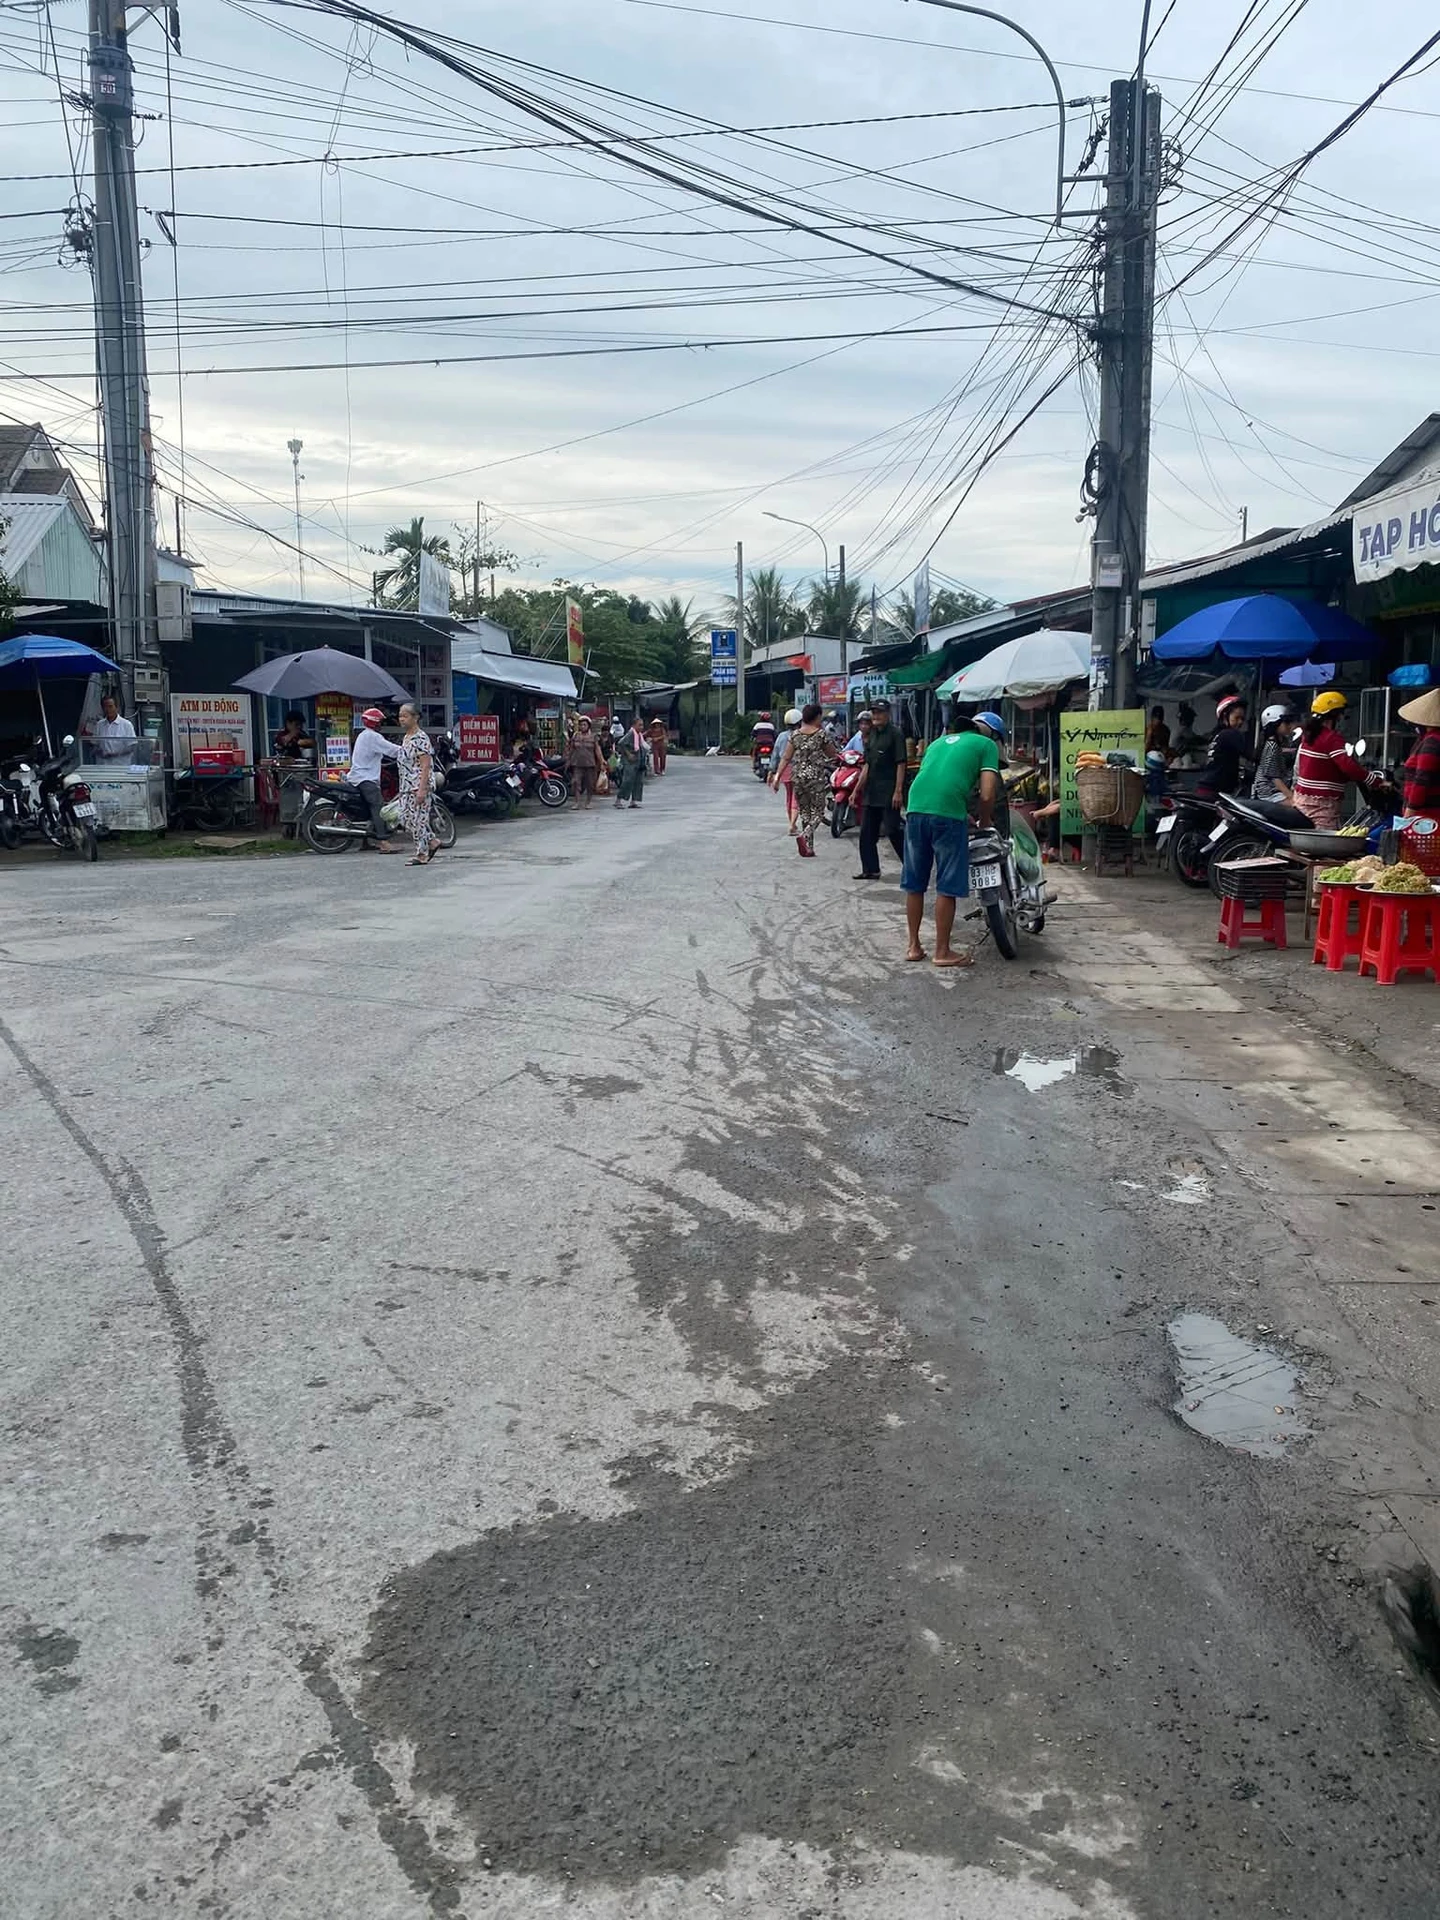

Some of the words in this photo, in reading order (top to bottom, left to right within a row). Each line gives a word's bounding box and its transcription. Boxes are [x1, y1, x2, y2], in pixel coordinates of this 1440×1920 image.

[1359, 517, 1402, 569] TẠP
[180, 700, 199, 712] ATM
[202, 701, 211, 712] DI
[214, 698, 239, 714] ĐỘNG
[482, 719, 496, 730] BÁN
[467, 749, 476, 758] XE
[477, 747, 492, 758] MÁY
[971, 876, 997, 889] 9085
